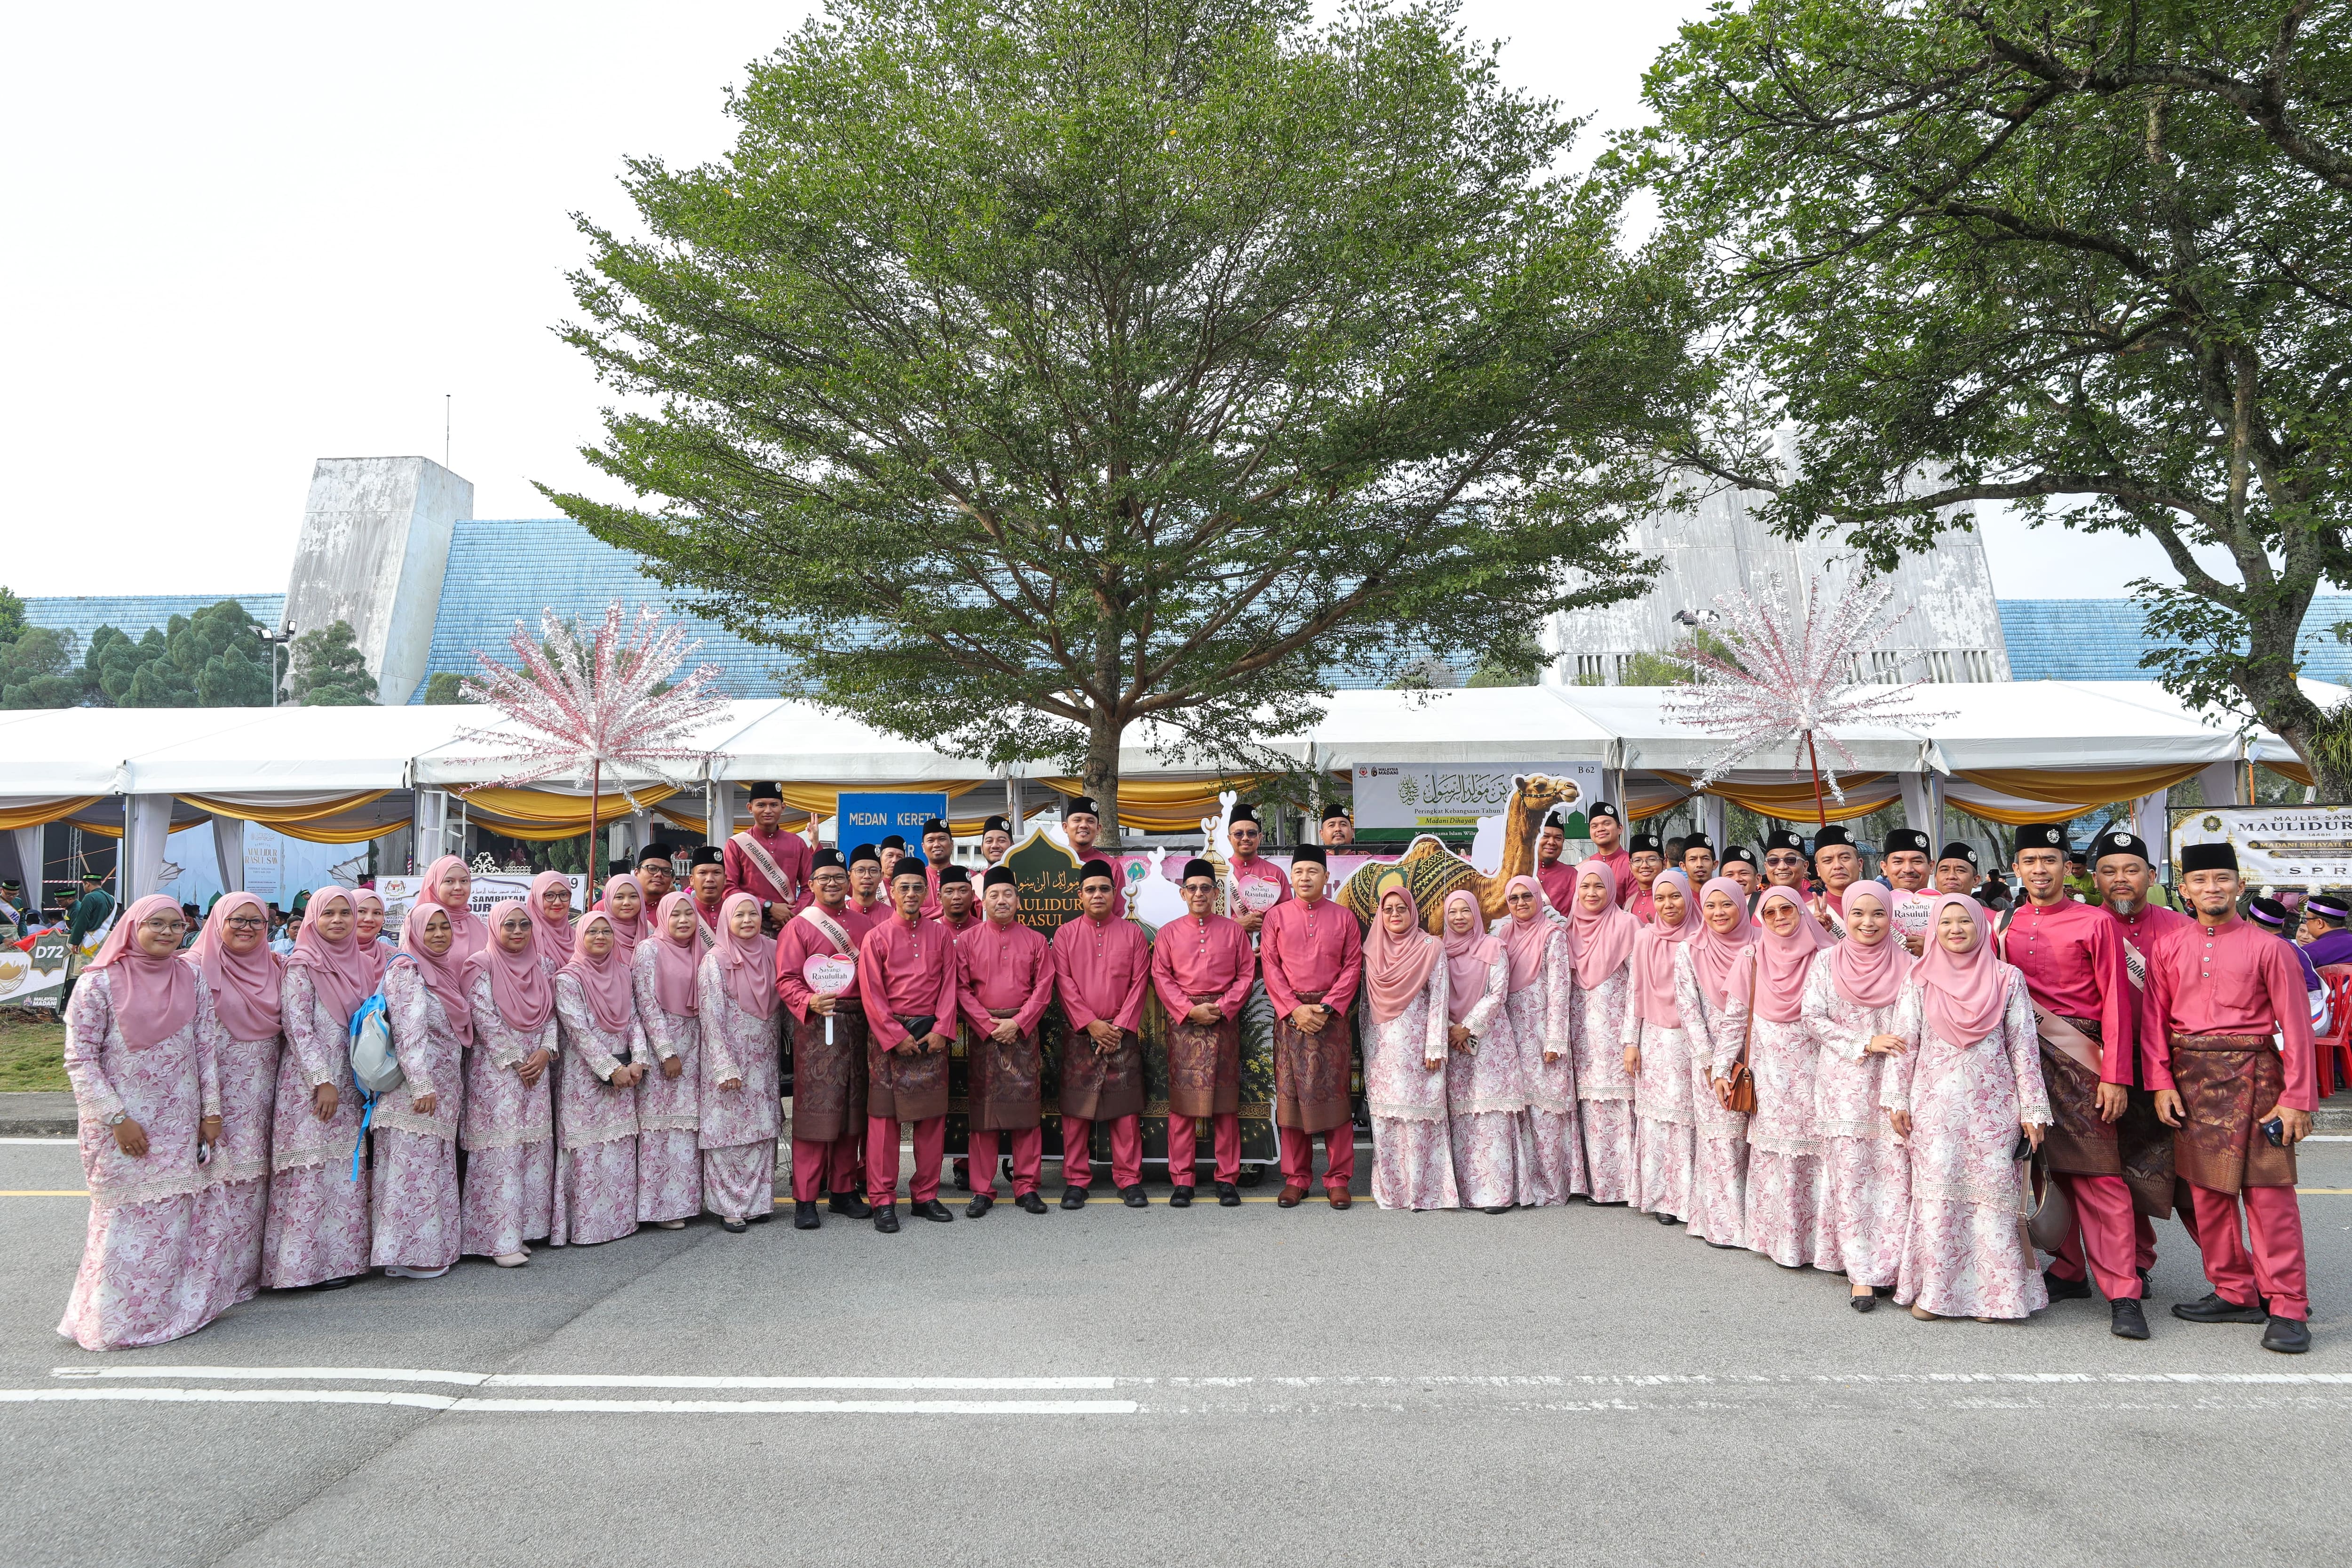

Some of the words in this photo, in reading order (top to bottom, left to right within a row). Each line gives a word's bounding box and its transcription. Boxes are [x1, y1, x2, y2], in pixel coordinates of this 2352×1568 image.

[849, 813, 887, 826] MEDAN
[2238, 821, 2352, 831] MAULIDUR
[746, 843, 773, 872] PERBADANAN
[770, 870, 789, 897] PUTRAJAYA
[1017, 914, 1066, 926] RASUL
[821, 920, 850, 954] PERBADANAN
[35, 946, 64, 958] D72
